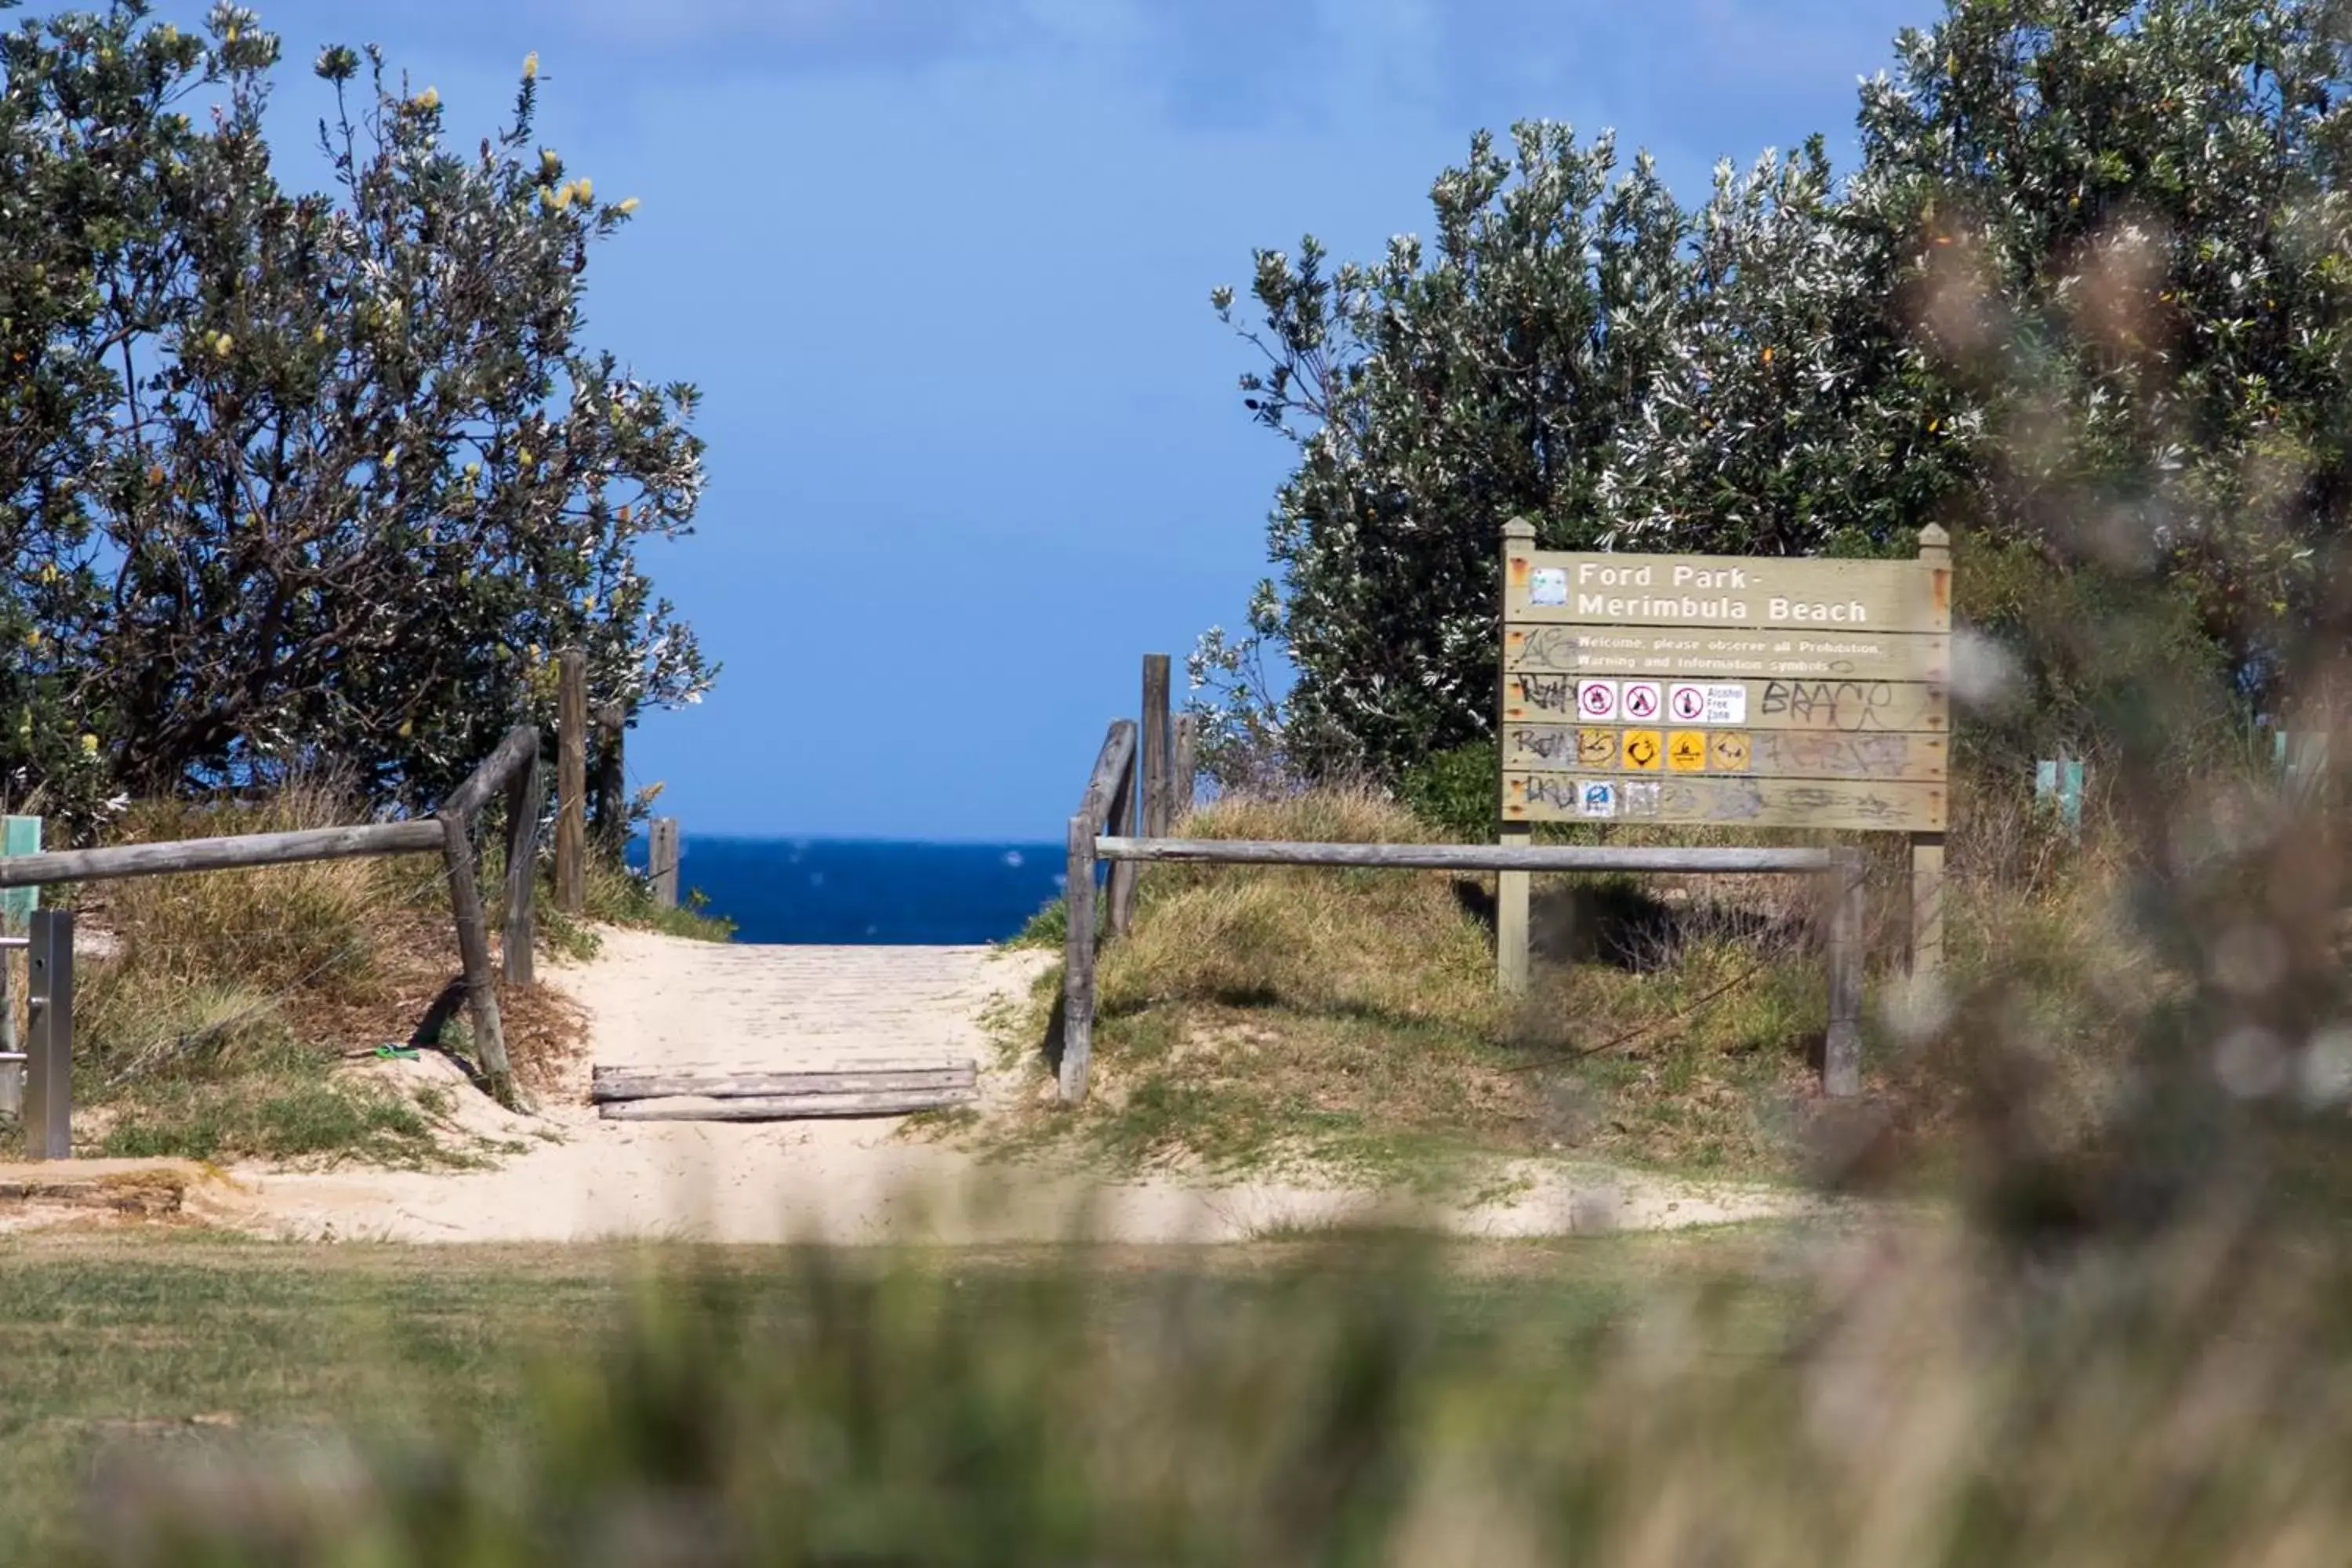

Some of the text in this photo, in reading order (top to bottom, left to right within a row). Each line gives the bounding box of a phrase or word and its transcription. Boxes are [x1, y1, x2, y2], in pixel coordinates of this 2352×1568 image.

[1578, 563, 1651, 586] Ford
[1578, 593, 1867, 622] Merimbula Beach
[1653, 638, 1700, 650] please
[1708, 640, 1766, 652] observe
[1773, 641, 1791, 652] all
[1577, 655, 1635, 668] Warning
[1643, 656, 1670, 666] and
[1769, 660, 1830, 672] symbols
[1708, 698, 1728, 708] Free
[1707, 710, 1730, 720] Zone
